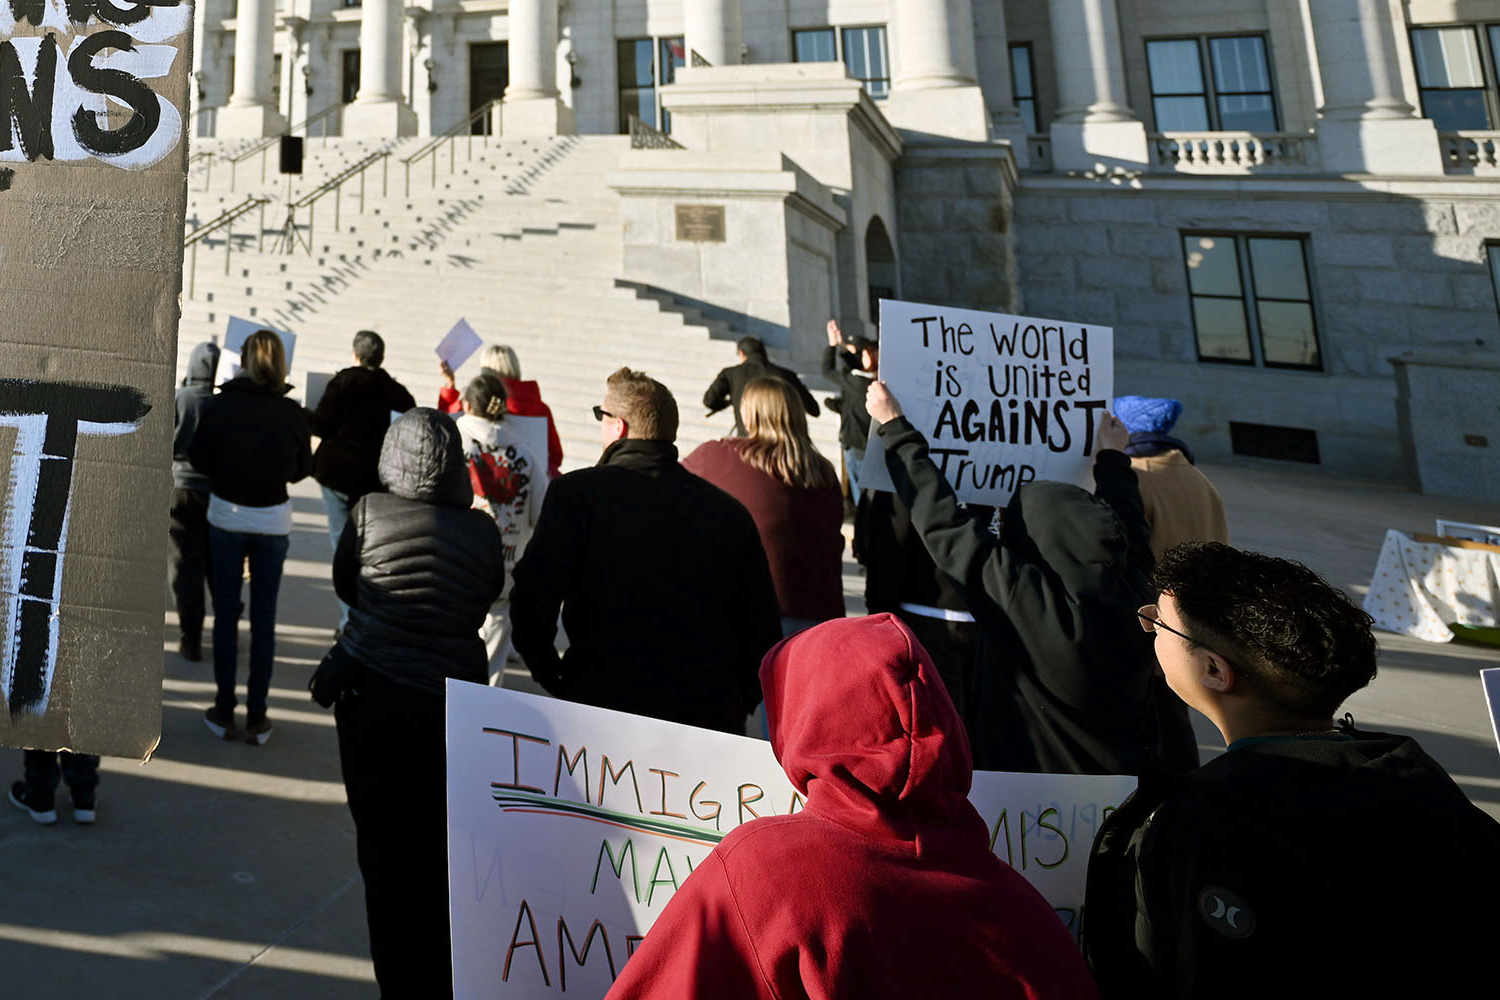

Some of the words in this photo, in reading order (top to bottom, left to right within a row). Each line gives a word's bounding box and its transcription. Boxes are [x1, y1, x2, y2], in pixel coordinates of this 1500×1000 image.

[911, 316, 974, 355] The
[934, 360, 962, 397] is
[589, 836, 696, 907] MA
